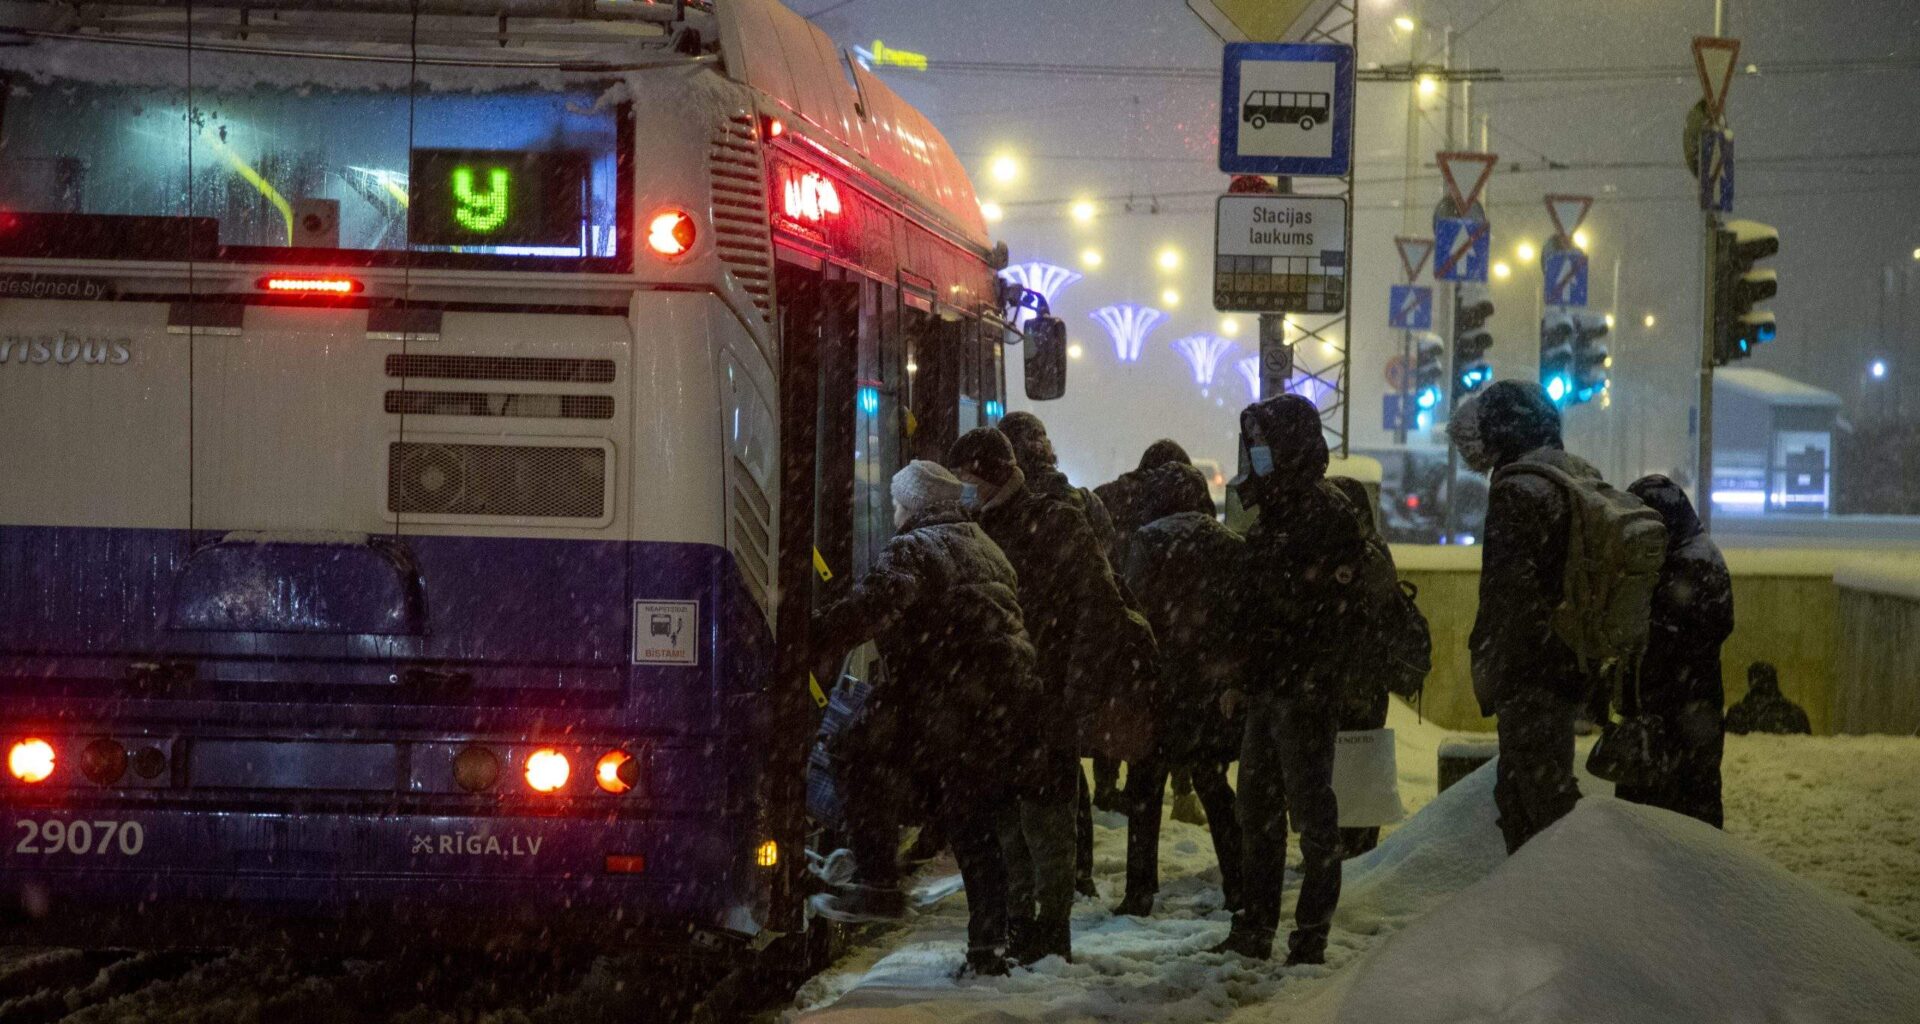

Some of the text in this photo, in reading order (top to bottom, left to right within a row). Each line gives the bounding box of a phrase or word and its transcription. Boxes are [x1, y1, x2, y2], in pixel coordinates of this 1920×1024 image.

[1253, 206, 1312, 228] Stacijas
[1250, 228, 1313, 245] laukums
[0, 276, 105, 300] designed by
[16, 819, 144, 855] 29070
[439, 831, 543, 856] RĪGA.LV
